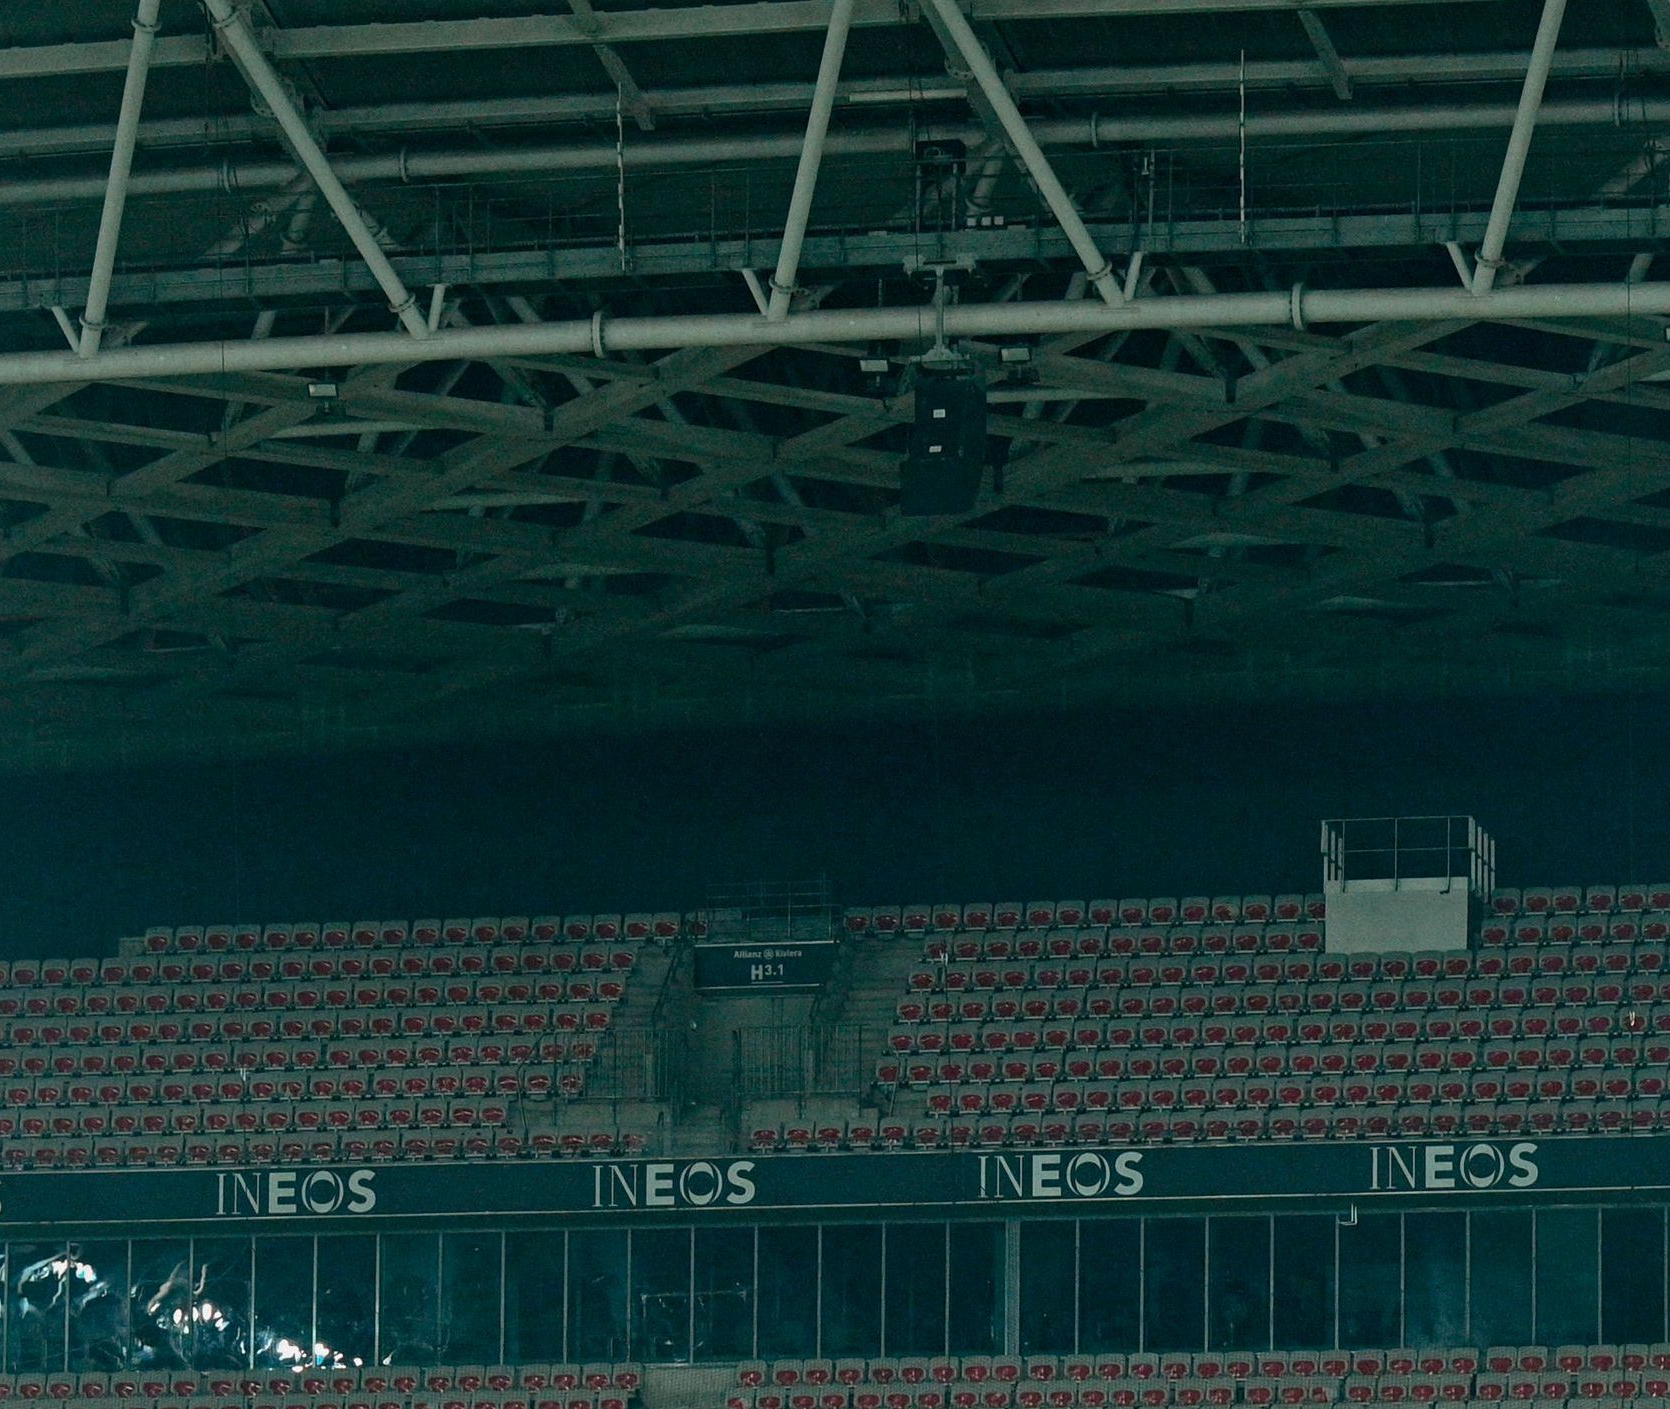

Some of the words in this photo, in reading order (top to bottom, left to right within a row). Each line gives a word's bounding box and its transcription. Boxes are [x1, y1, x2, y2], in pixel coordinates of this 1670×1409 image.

[593, 1160, 755, 1208] INEOS
[978, 1151, 1145, 1198] INEOS
[1370, 1142, 1539, 1190] INEOS
[216, 1170, 378, 1218] INEOS
